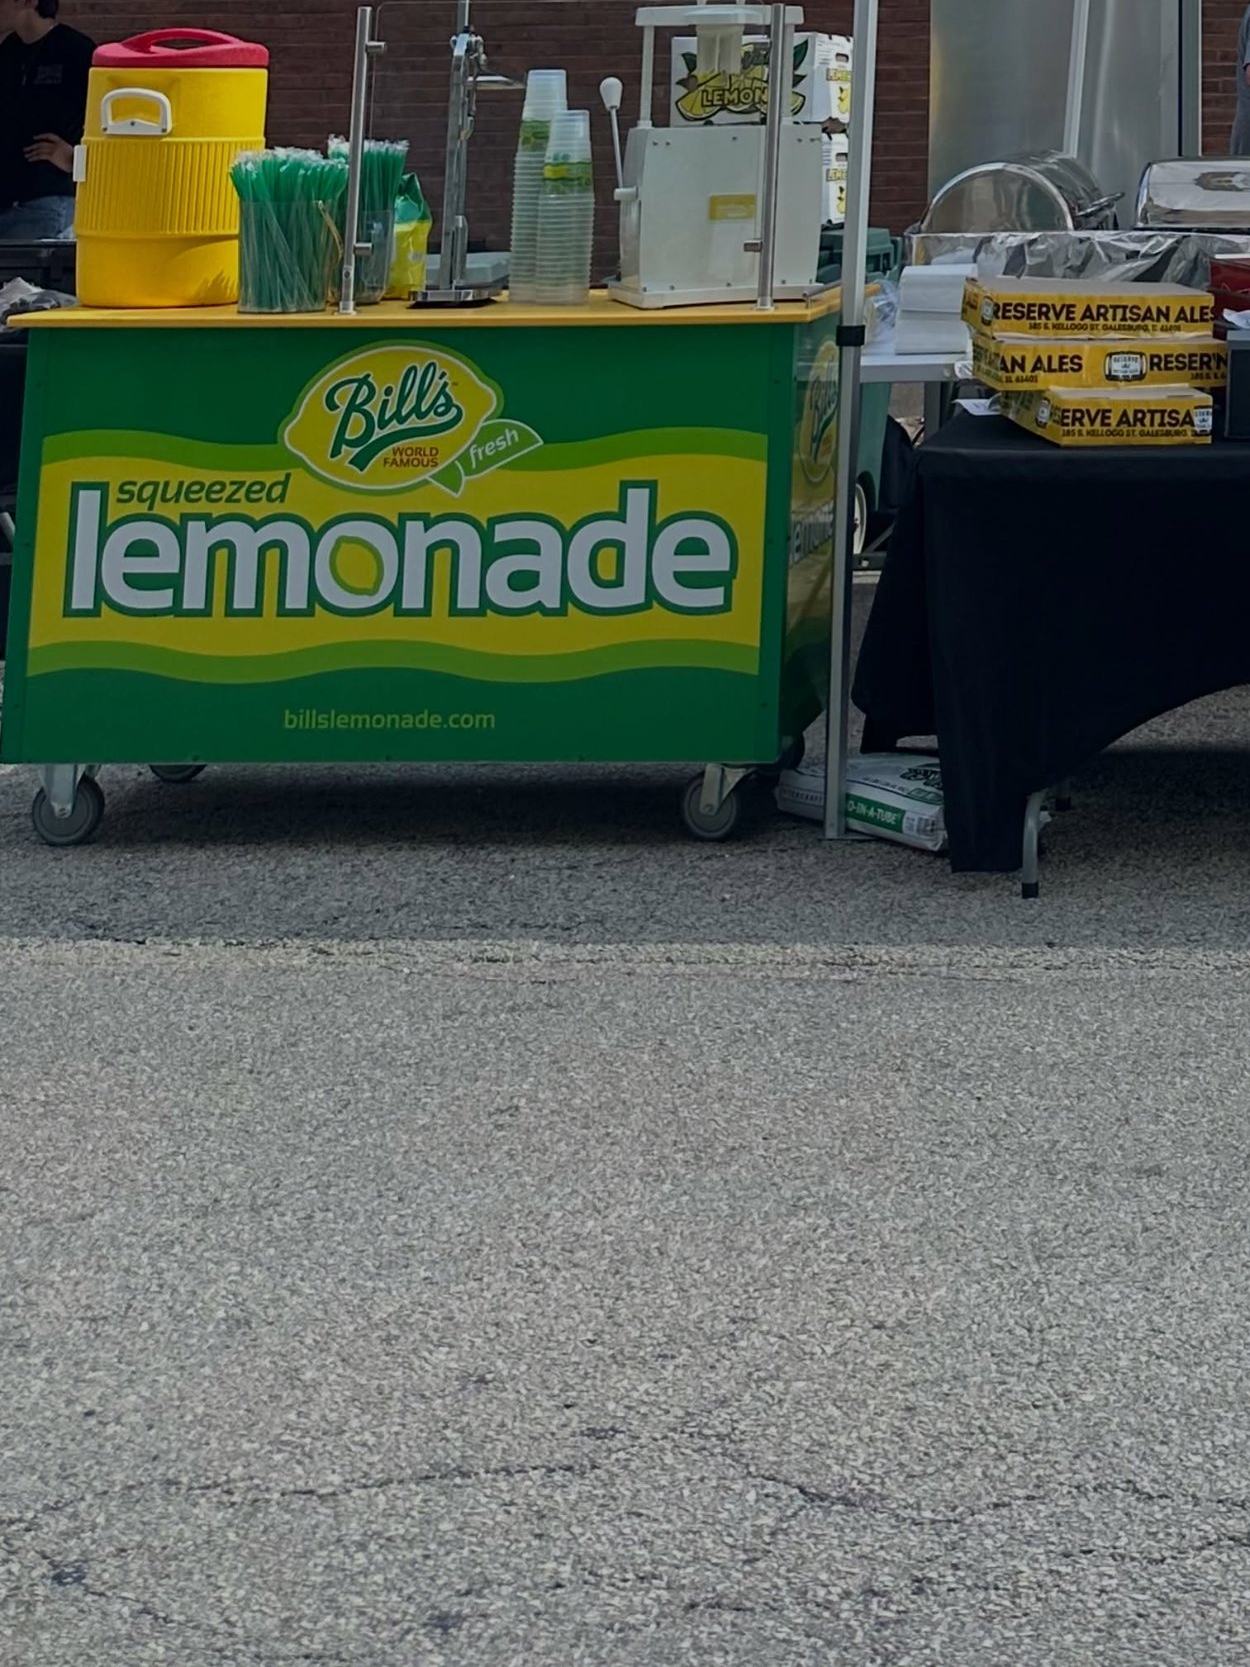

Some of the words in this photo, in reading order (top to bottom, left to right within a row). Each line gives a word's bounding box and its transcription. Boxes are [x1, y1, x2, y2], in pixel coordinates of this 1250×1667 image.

[993, 302, 1077, 321] RESERVE
[1080, 303, 1170, 322] ARTISAN
[1030, 354, 1083, 373] ALES
[324, 361, 464, 472] Bill's
[1116, 408, 1195, 427] ARTISA
[392, 446, 439, 458] WORLD
[469, 427, 519, 469] fresh
[383, 456, 439, 468] FAMOUS
[116, 472, 292, 511] squeezed
[67, 484, 735, 614] lemonade
[283, 708, 496, 729] billslemonade.com
